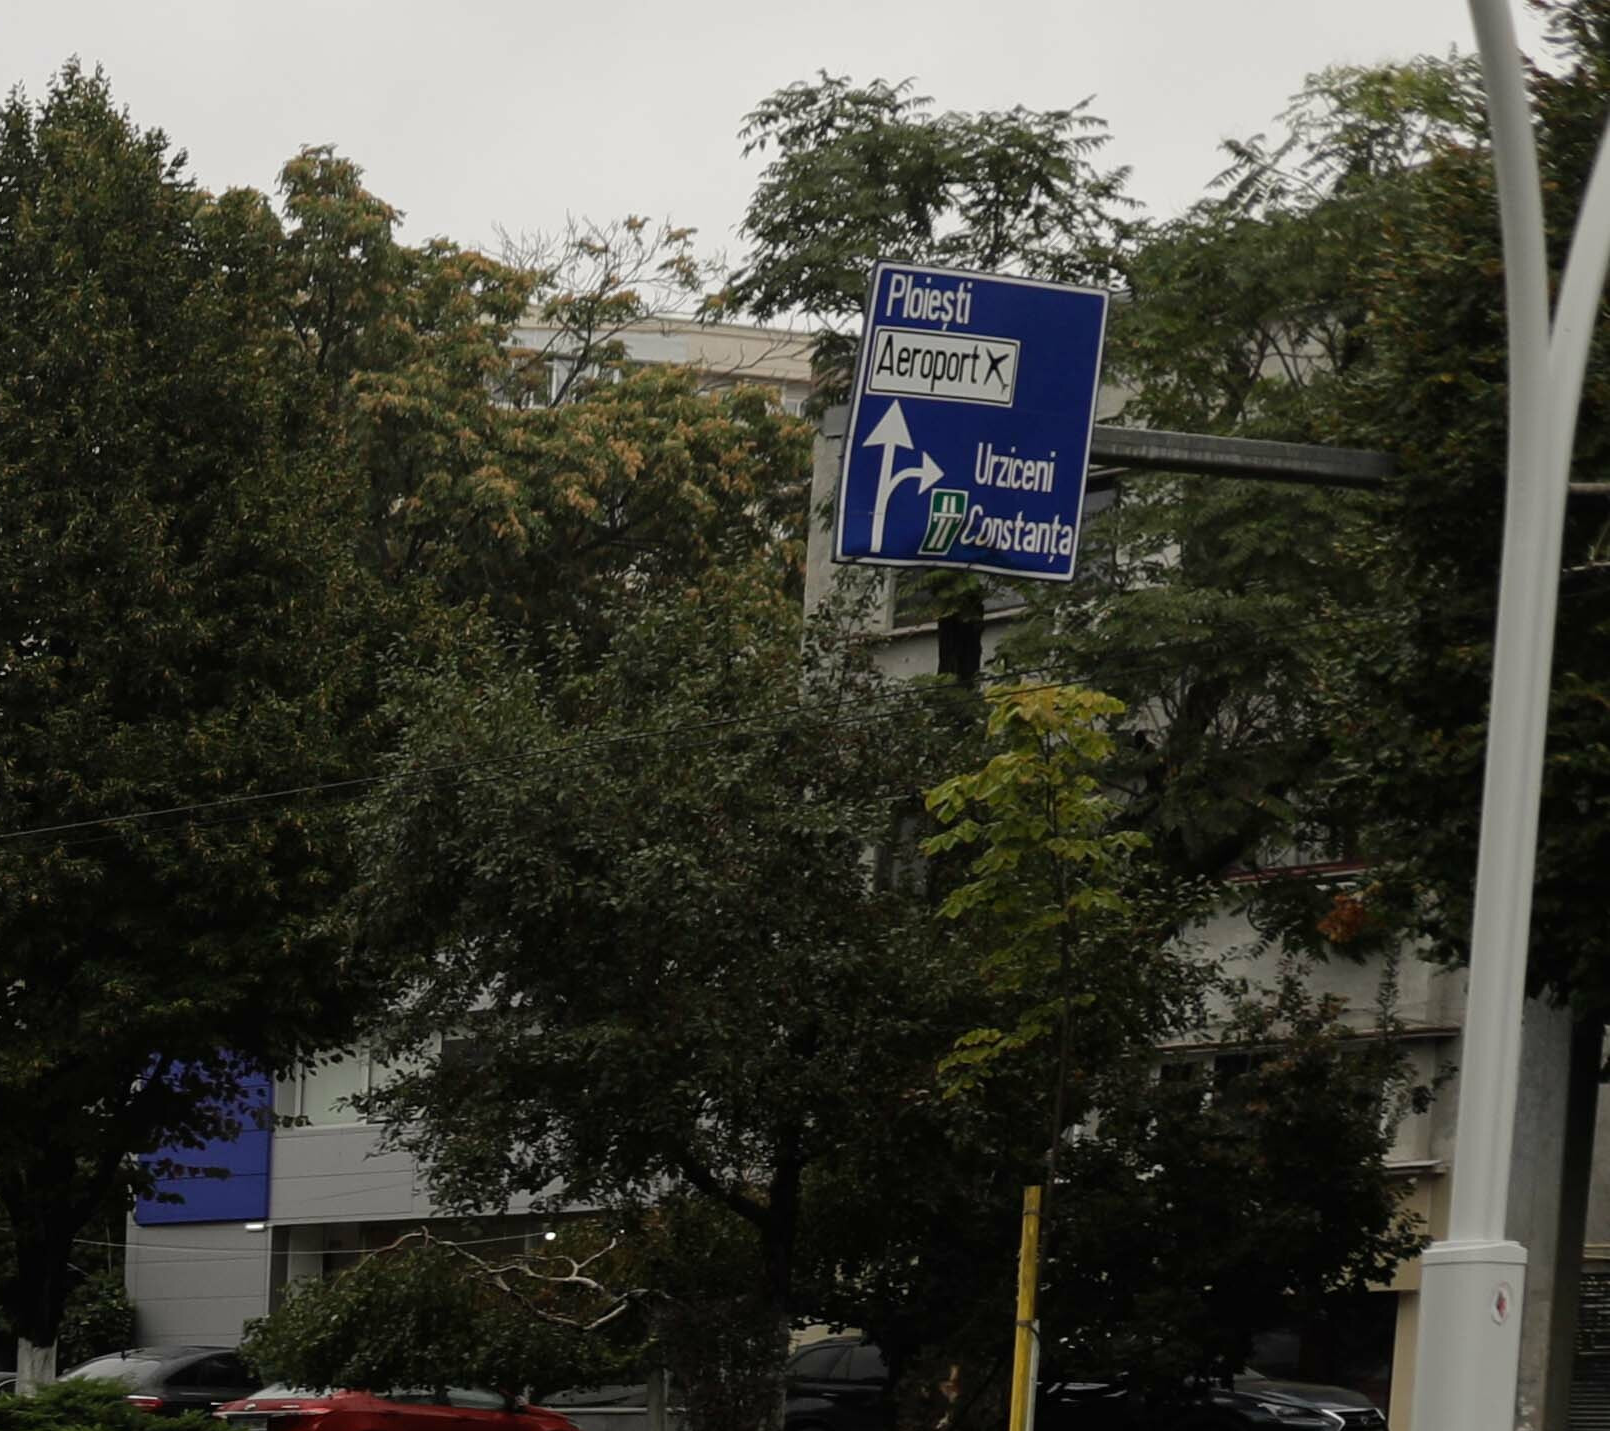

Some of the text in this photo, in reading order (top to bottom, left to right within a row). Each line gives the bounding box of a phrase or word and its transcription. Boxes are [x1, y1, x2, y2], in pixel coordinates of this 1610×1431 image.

[885, 273, 972, 330] Ploiești
[875, 334, 980, 392] Aeroport
[974, 441, 1057, 494] Urziceni
[959, 505, 1075, 564] Constanța
